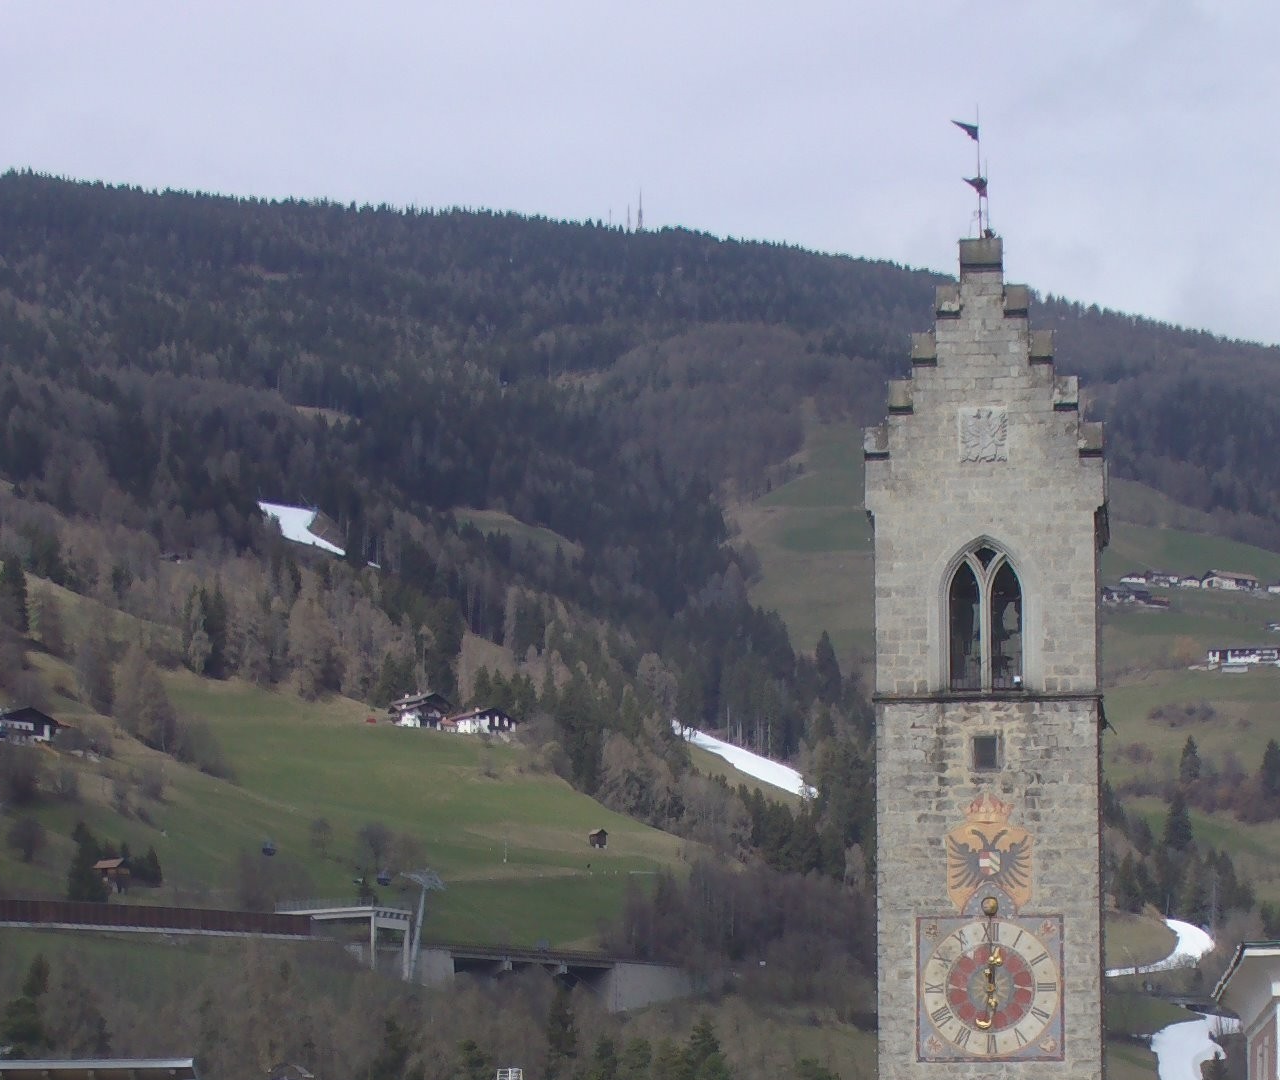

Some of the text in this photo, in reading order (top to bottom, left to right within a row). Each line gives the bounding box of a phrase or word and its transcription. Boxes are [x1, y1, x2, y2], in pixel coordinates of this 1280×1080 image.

[1030, 951, 1048, 966] II
[1037, 982, 1056, 992] III
[1014, 1028, 1028, 1046] V
